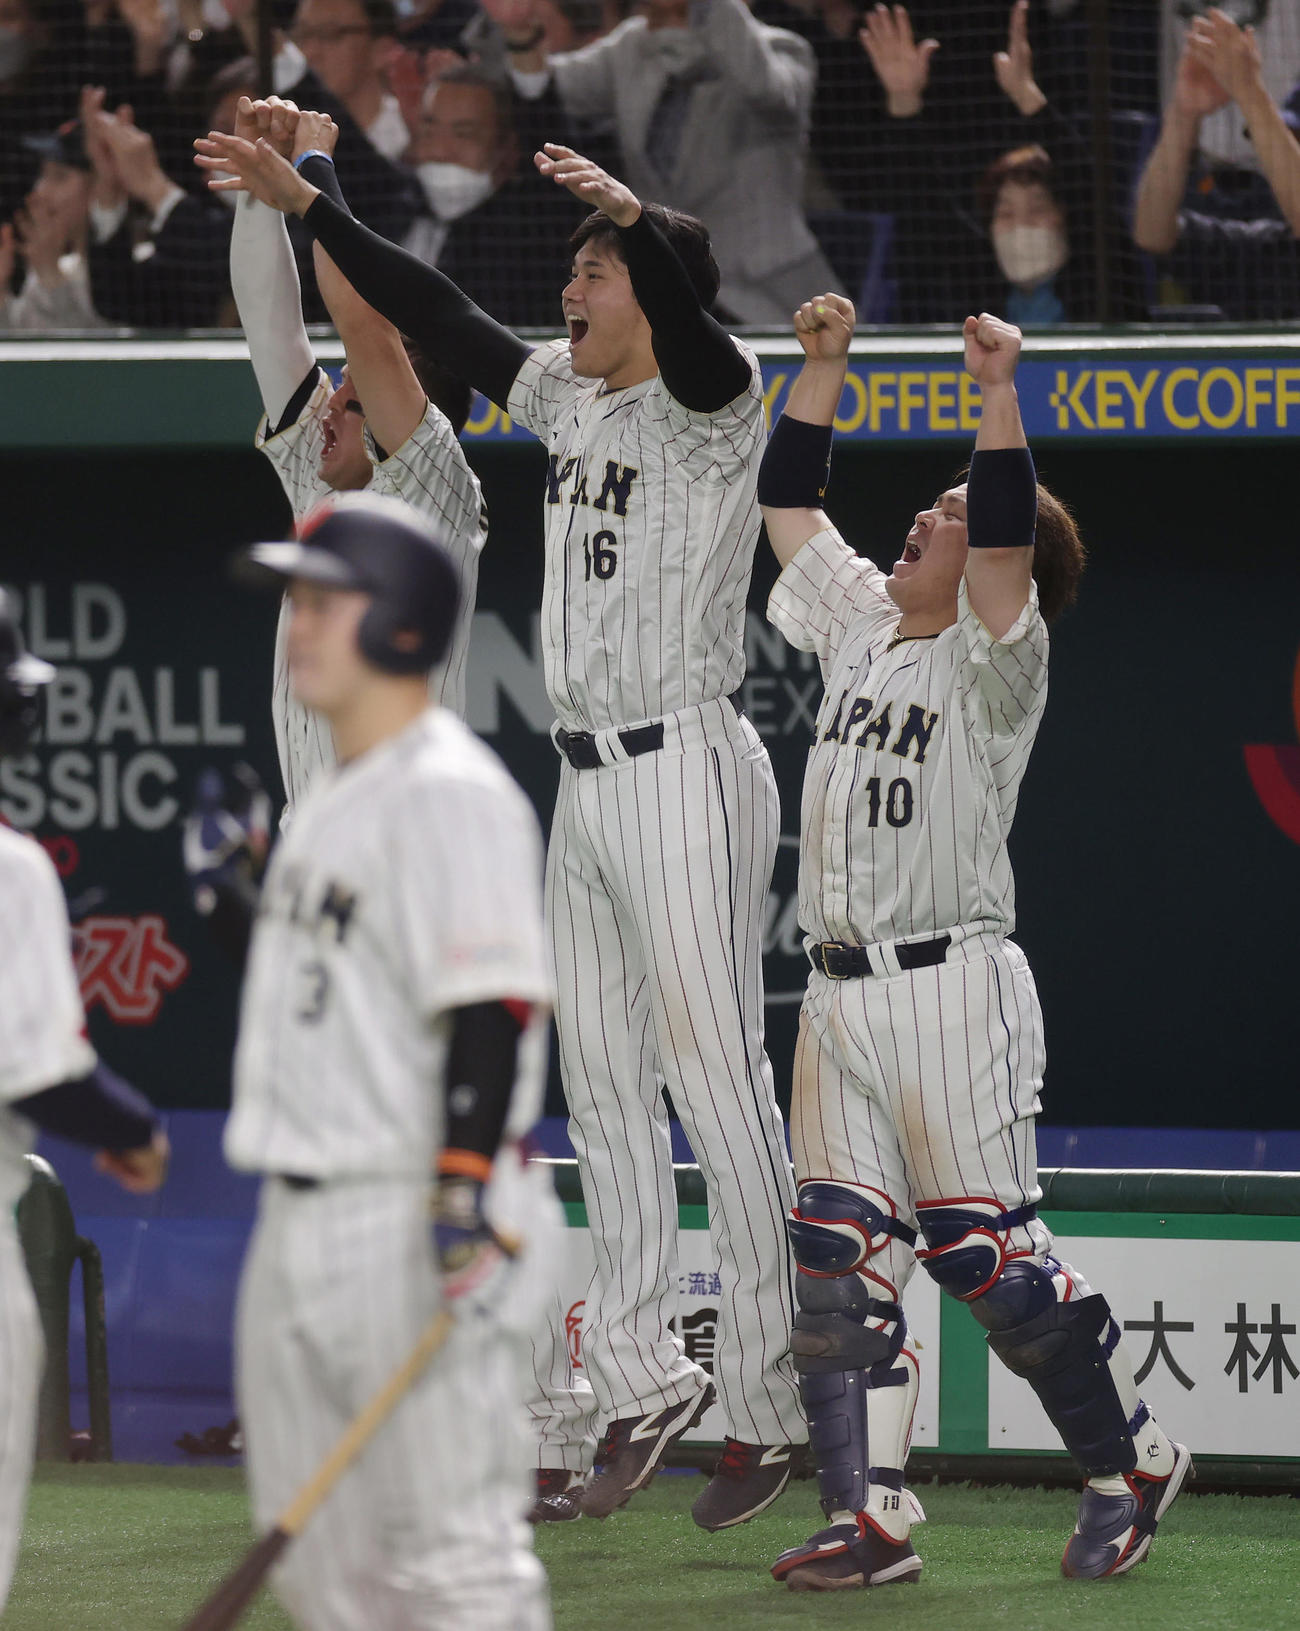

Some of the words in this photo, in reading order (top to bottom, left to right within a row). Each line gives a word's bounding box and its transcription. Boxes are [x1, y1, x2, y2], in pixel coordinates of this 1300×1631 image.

[788, 371, 984, 434] OFFEE
[582, 529, 618, 582] 16
[36, 667, 245, 746] BALL
[865, 776, 914, 828] 10
[679, 1271, 722, 1296] 流通
[1123, 1300, 1300, 1394] 大林
